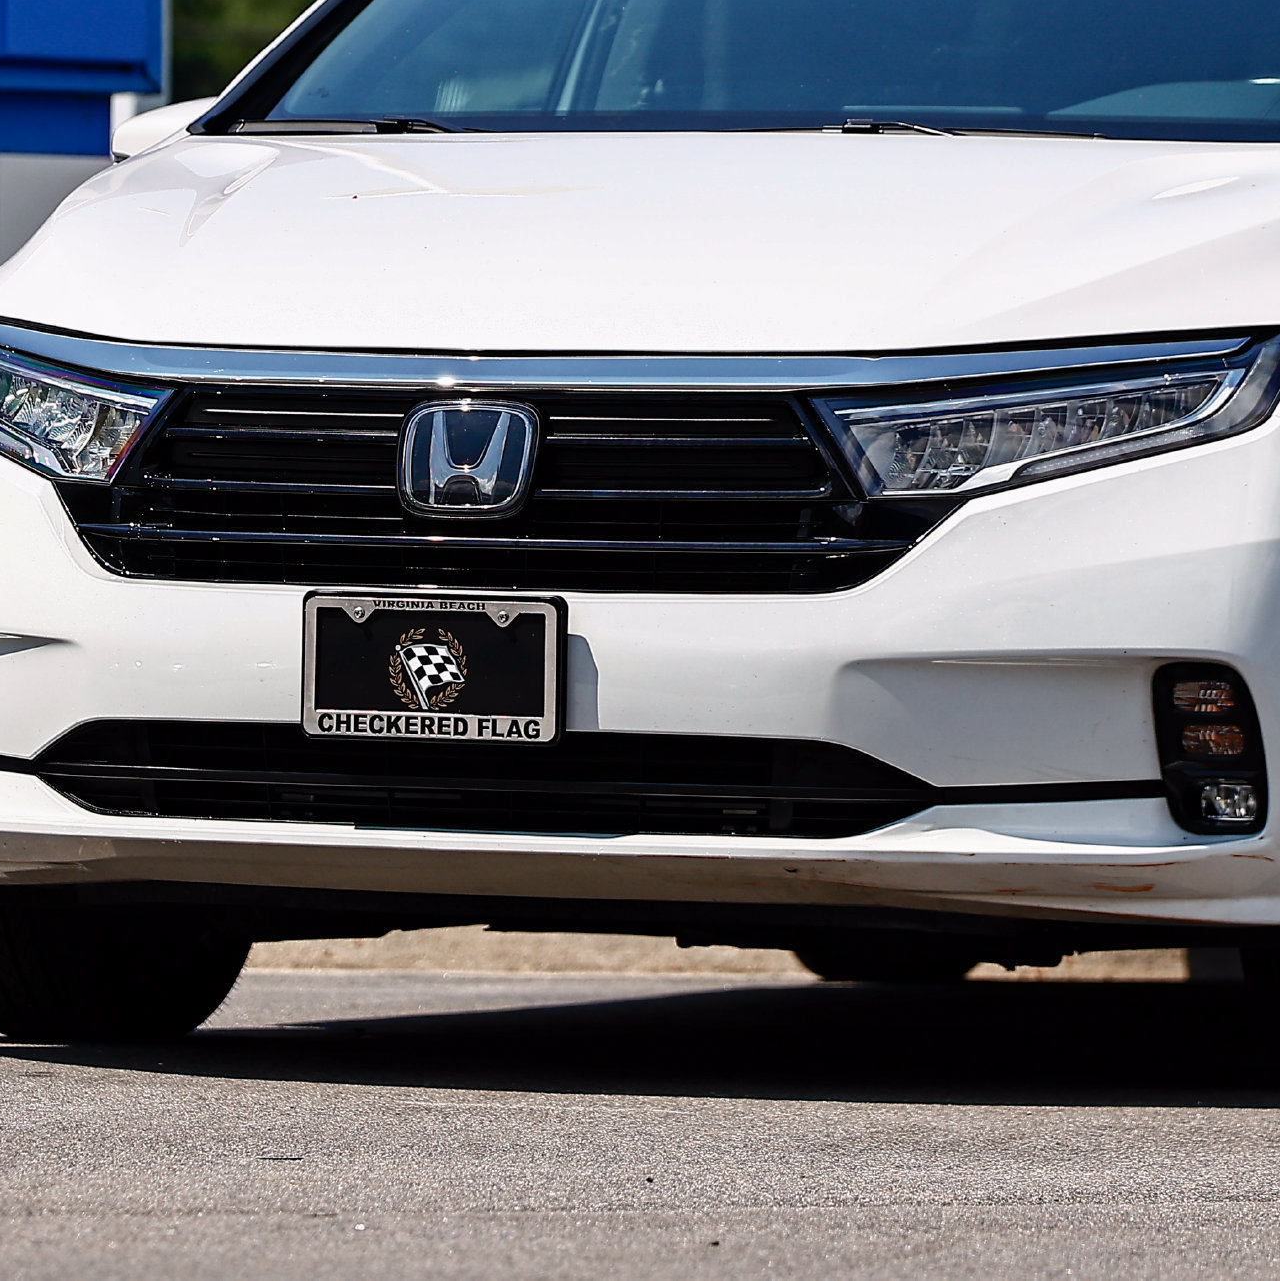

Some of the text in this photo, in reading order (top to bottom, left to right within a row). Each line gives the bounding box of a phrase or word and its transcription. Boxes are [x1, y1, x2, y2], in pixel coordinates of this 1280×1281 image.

[373, 600, 486, 611] VIRGINIA BEACH
[317, 713, 541, 740] CHECKERED FLAG
